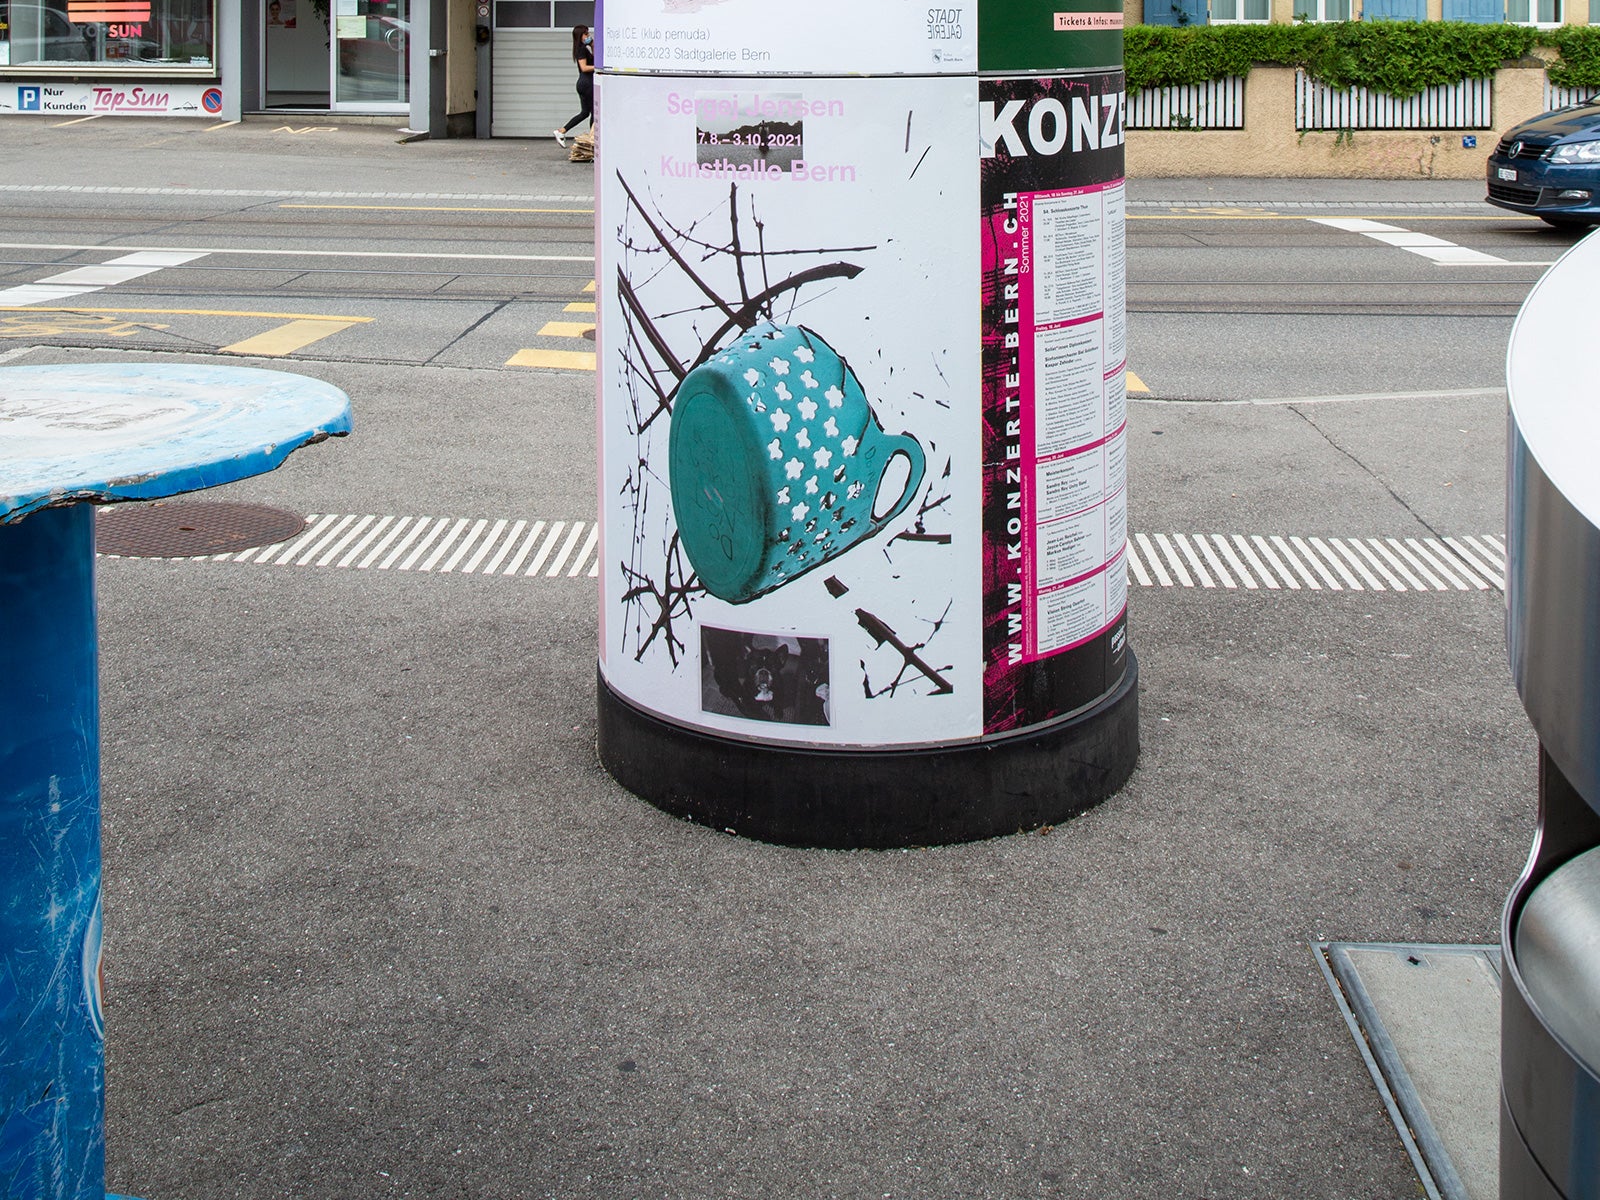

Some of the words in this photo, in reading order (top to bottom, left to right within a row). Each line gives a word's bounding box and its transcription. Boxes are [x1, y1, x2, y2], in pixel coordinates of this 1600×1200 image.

[927, 9, 962, 24] STADT
[1059, 17, 1085, 26] Tickets
[1087, 17, 1092, 25] &
[109, 24, 142, 38] SUN
[641, 27, 661, 41] (klub
[665, 28, 710, 42] pemuda)
[674, 48, 736, 63] Stadtgalerie
[741, 48, 771, 61] Bern
[43, 88, 64, 96] Nur
[92, 87, 126, 111] Top
[127, 87, 169, 106] Sun
[44, 102, 87, 110] Kunden
[667, 92, 739, 121] Sergej
[745, 94, 845, 117] Jensen
[767, 134, 801, 147] 2021
[660, 156, 783, 180] Kunsthalle
[791, 159, 856, 182] Bern
[1019, 195, 1029, 222] 2021
[1020, 226, 1030, 274] Sommer
